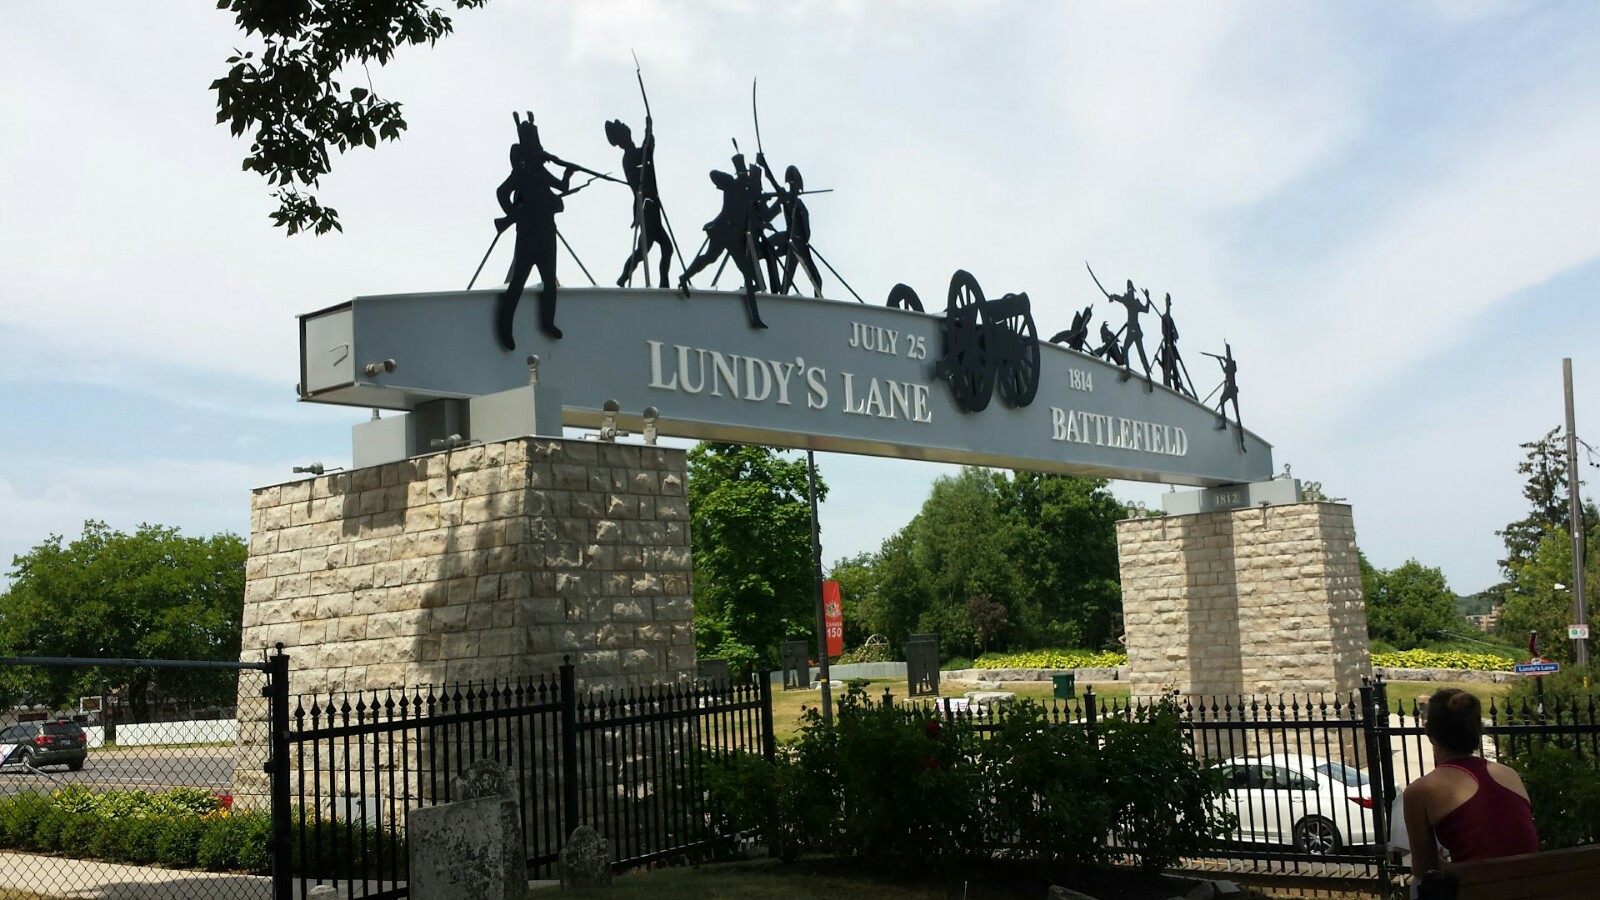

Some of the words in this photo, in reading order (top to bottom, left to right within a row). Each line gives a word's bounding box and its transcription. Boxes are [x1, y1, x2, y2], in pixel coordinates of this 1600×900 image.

[849, 322, 899, 356] JULY
[906, 334, 927, 360] 25
[646, 339, 829, 410] LUNDY'S
[840, 372, 932, 423] LANE
[1068, 368, 1093, 393] 1814
[1050, 406, 1188, 457] BATTLEFIELD
[1216, 493, 1239, 505] 1812
[827, 627, 842, 638] 150
